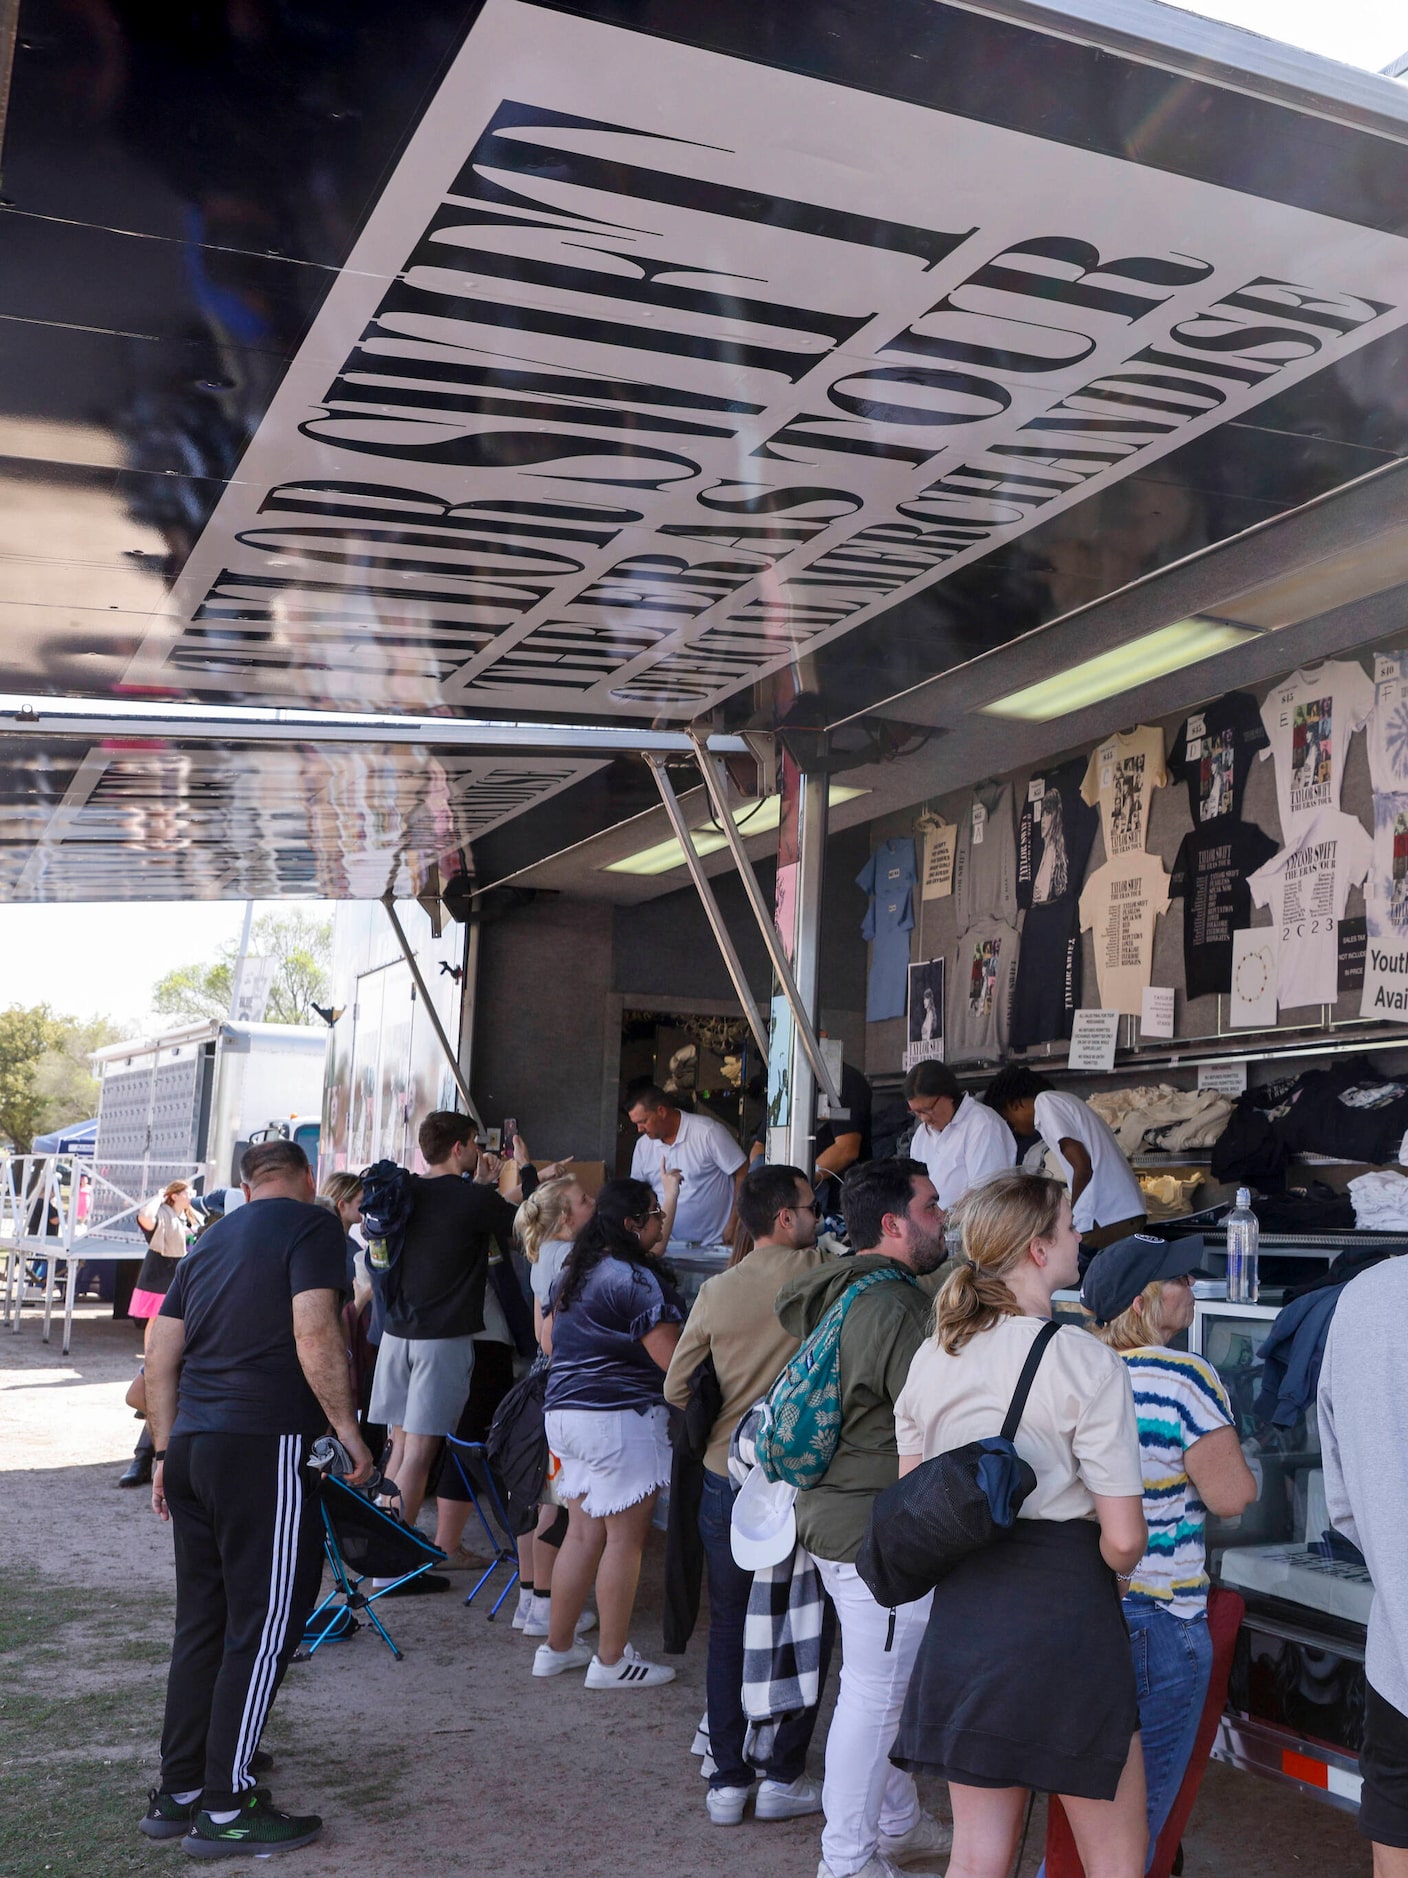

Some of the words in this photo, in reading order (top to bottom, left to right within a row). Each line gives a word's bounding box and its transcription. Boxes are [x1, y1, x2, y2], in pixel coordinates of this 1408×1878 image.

[297, 98, 980, 492] SWIFT
[749, 236, 1214, 470] TOUR
[610, 597, 870, 702] OFFICIAL
[778, 274, 1399, 596] MERCHANDISE
[160, 480, 643, 684] TAYLOR
[564, 477, 863, 620] ERAS
[463, 619, 679, 692] THE
[1280, 712, 1288, 727] E
[1290, 785, 1313, 804] TAYLOR
[1314, 782, 1331, 799] SWIFT
[1285, 870, 1298, 881] THE
[1298, 865, 1317, 876] ERAS
[1314, 840, 1338, 862] SWIFT
[1343, 935, 1356, 944] SALES
[1357, 934, 1366, 942] TAX
